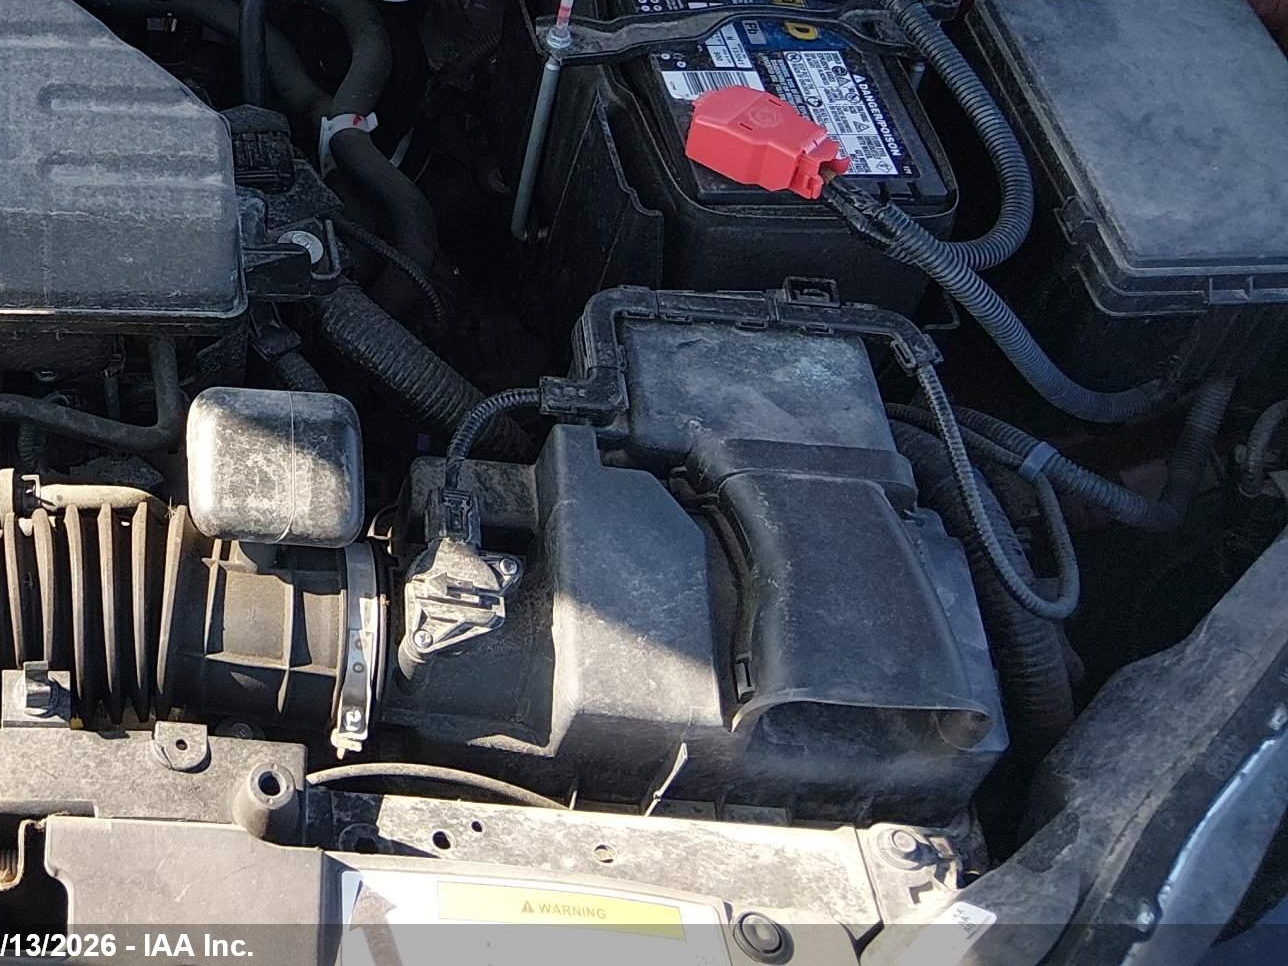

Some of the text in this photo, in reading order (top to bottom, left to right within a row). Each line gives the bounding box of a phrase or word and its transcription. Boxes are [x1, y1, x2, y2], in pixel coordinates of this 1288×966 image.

[742, 22, 762, 34] Pb
[857, 83, 901, 155] DANGER/POISON
[539, 903, 607, 919] WARNING
